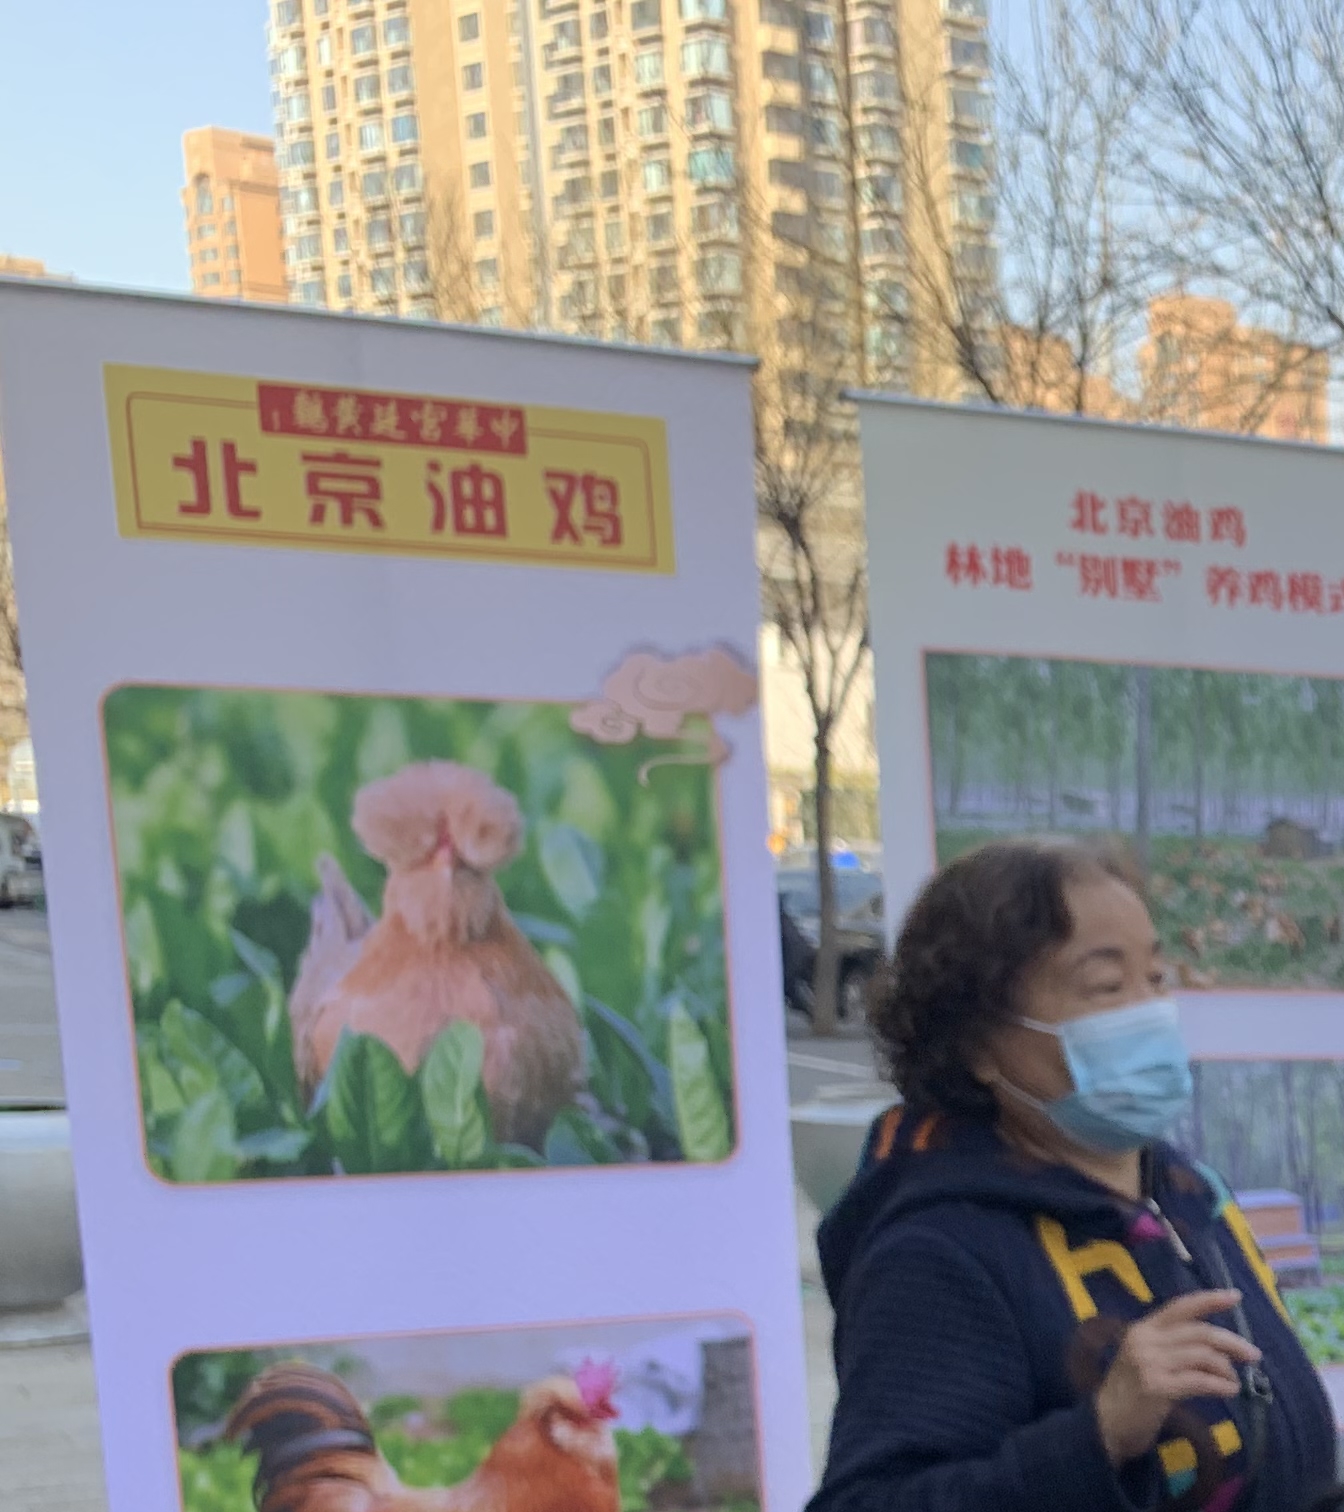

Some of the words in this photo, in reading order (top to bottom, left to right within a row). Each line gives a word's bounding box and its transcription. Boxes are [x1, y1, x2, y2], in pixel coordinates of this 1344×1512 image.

[172, 436, 624, 548] 北京油鸡
[1068, 488, 1247, 548] 北京油鸡
